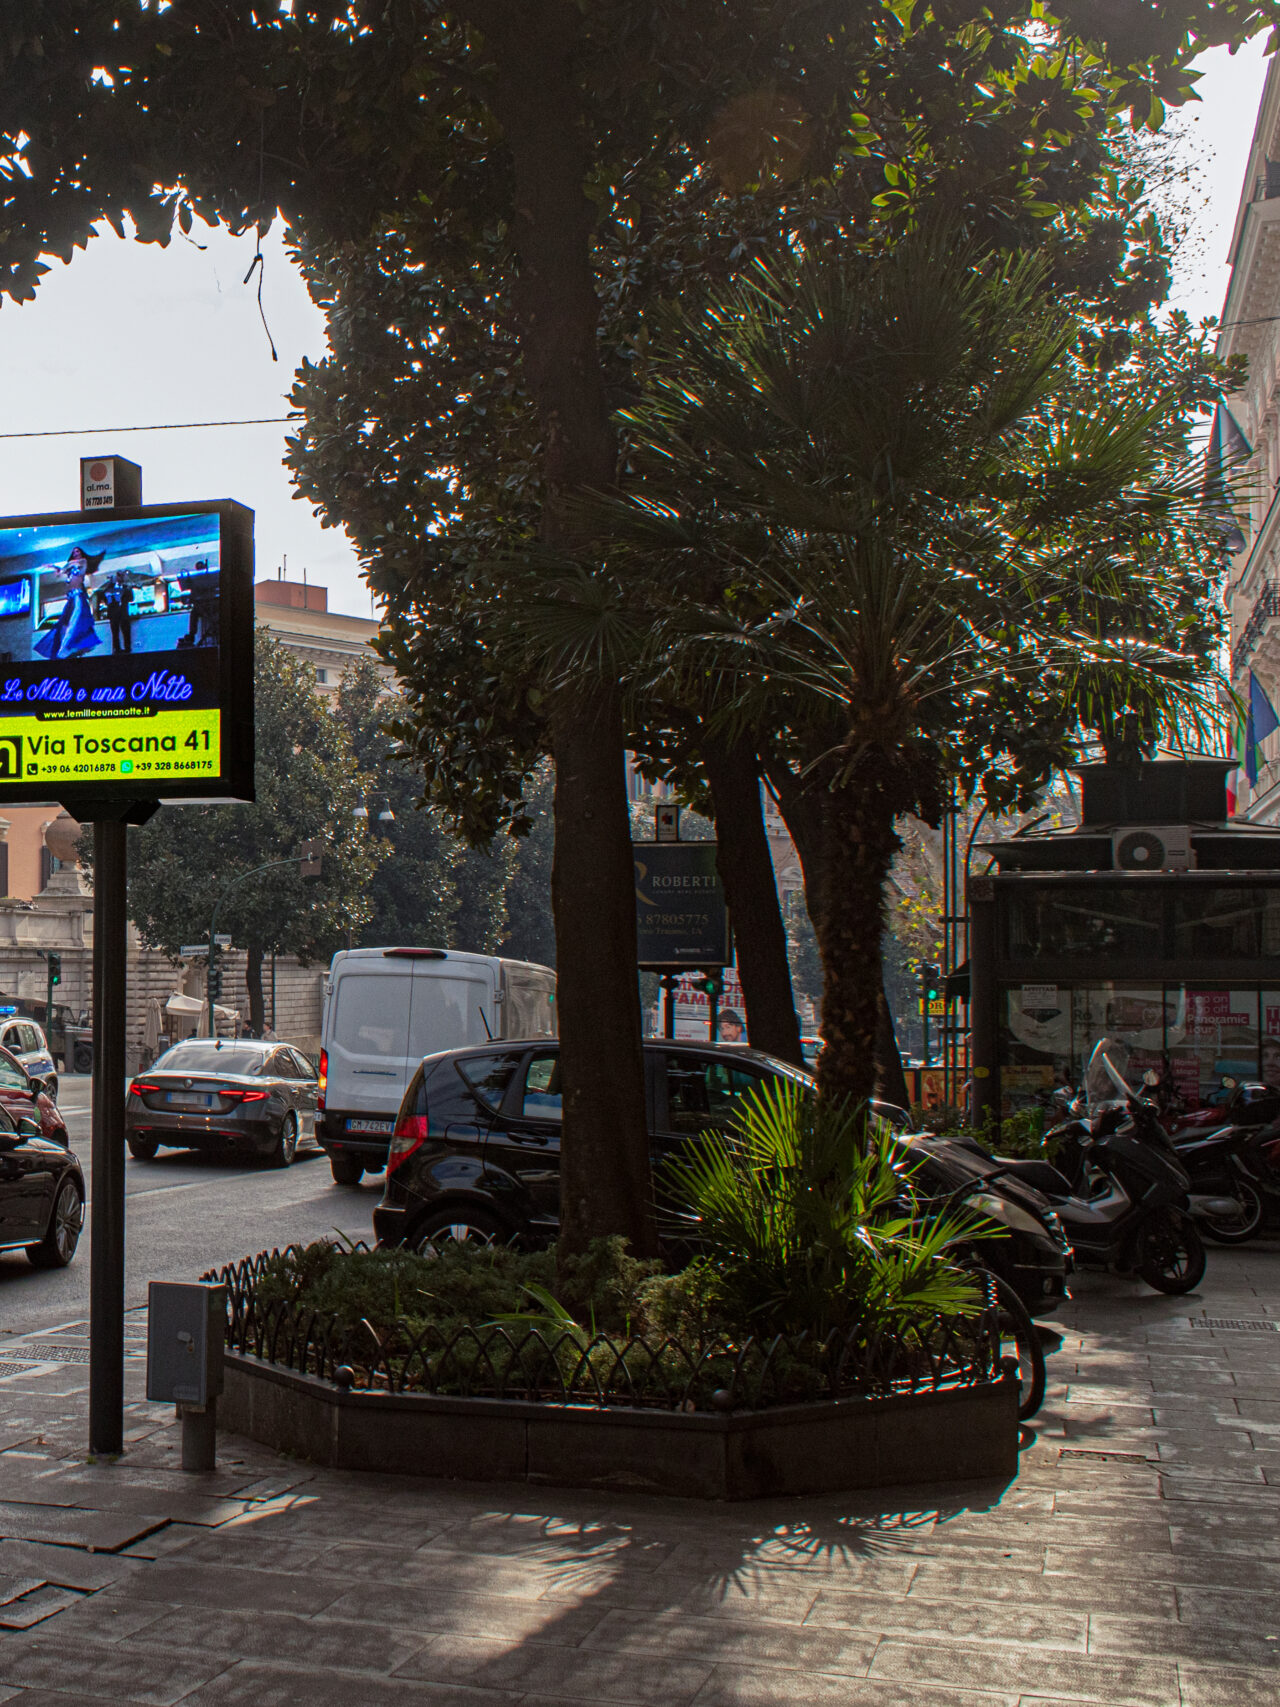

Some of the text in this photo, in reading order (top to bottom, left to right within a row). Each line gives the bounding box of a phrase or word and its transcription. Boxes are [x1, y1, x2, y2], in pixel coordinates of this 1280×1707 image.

[0, 669, 193, 702] Le Mille e una Notte
[43, 706, 150, 719] www.lemilleeunanotte.it
[27, 729, 210, 755] Via Toscana 41
[41, 763, 116, 773] +39 06 42016878
[135, 760, 212, 771] +39 328 8668175
[652, 875, 716, 888] ROBERTI
[1187, 1013, 1248, 1024] Panoramic
